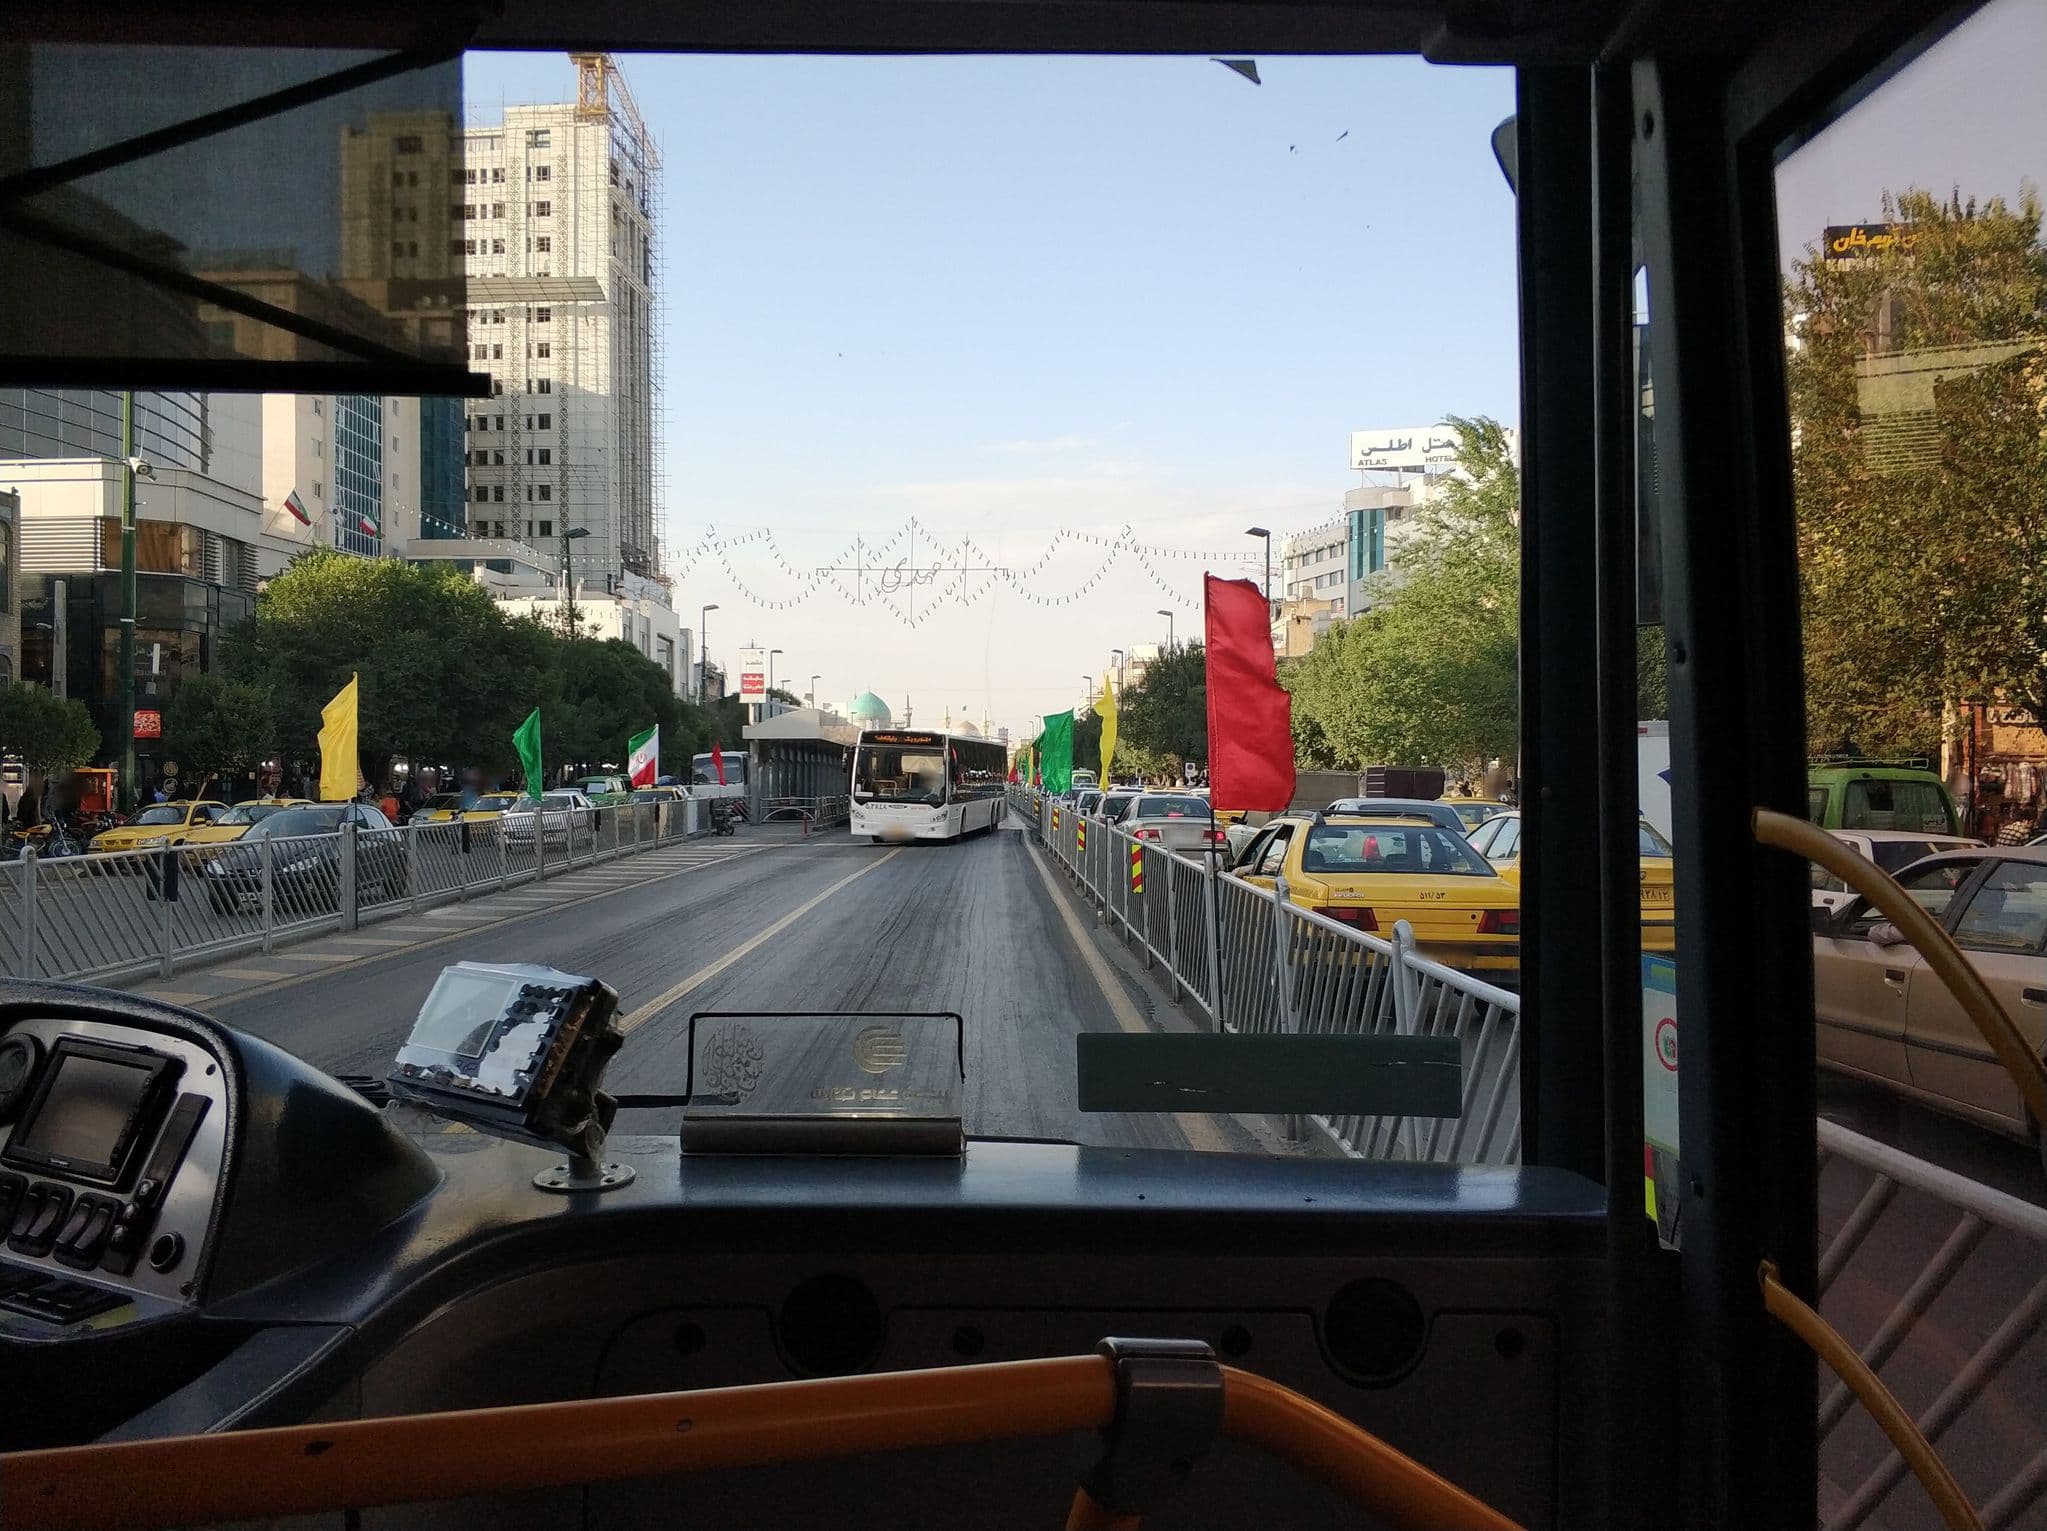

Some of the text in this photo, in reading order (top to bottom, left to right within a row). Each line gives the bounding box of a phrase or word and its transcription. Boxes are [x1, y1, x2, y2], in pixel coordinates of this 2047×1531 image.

[1361, 437, 1412, 457] اطلس
[1358, 455, 1455, 467] ATLAS HOTEL
